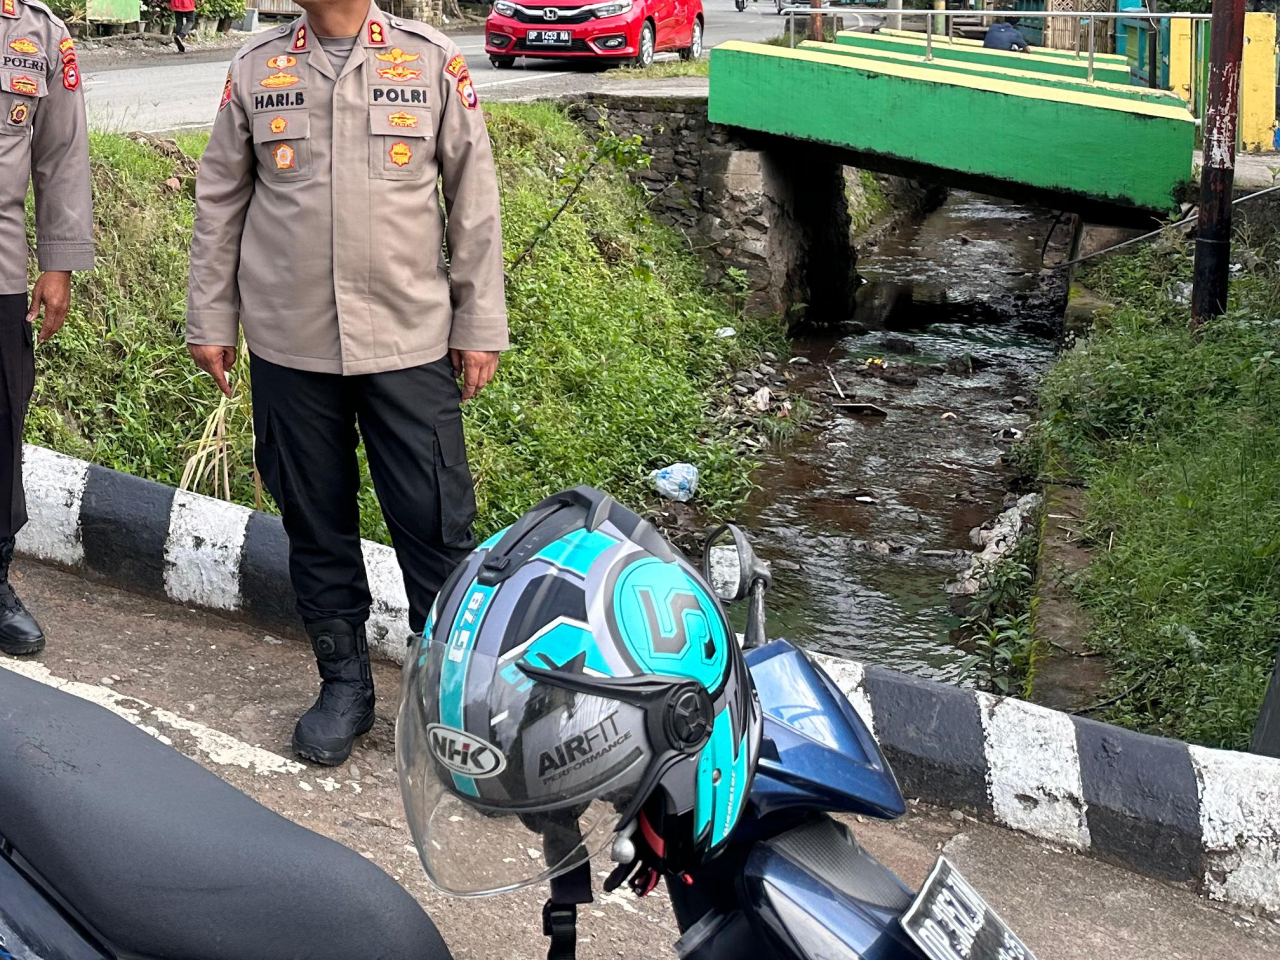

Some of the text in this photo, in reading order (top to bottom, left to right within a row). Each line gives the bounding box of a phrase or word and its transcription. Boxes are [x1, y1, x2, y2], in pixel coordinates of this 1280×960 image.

[541, 31, 557, 40] 1453
[3, 56, 45, 72] POLRI
[254, 91, 305, 110] HARI.B
[373, 88, 427, 104] POLRI
[432, 731, 488, 770] NHK
[542, 731, 633, 785] PERFORMANCE
